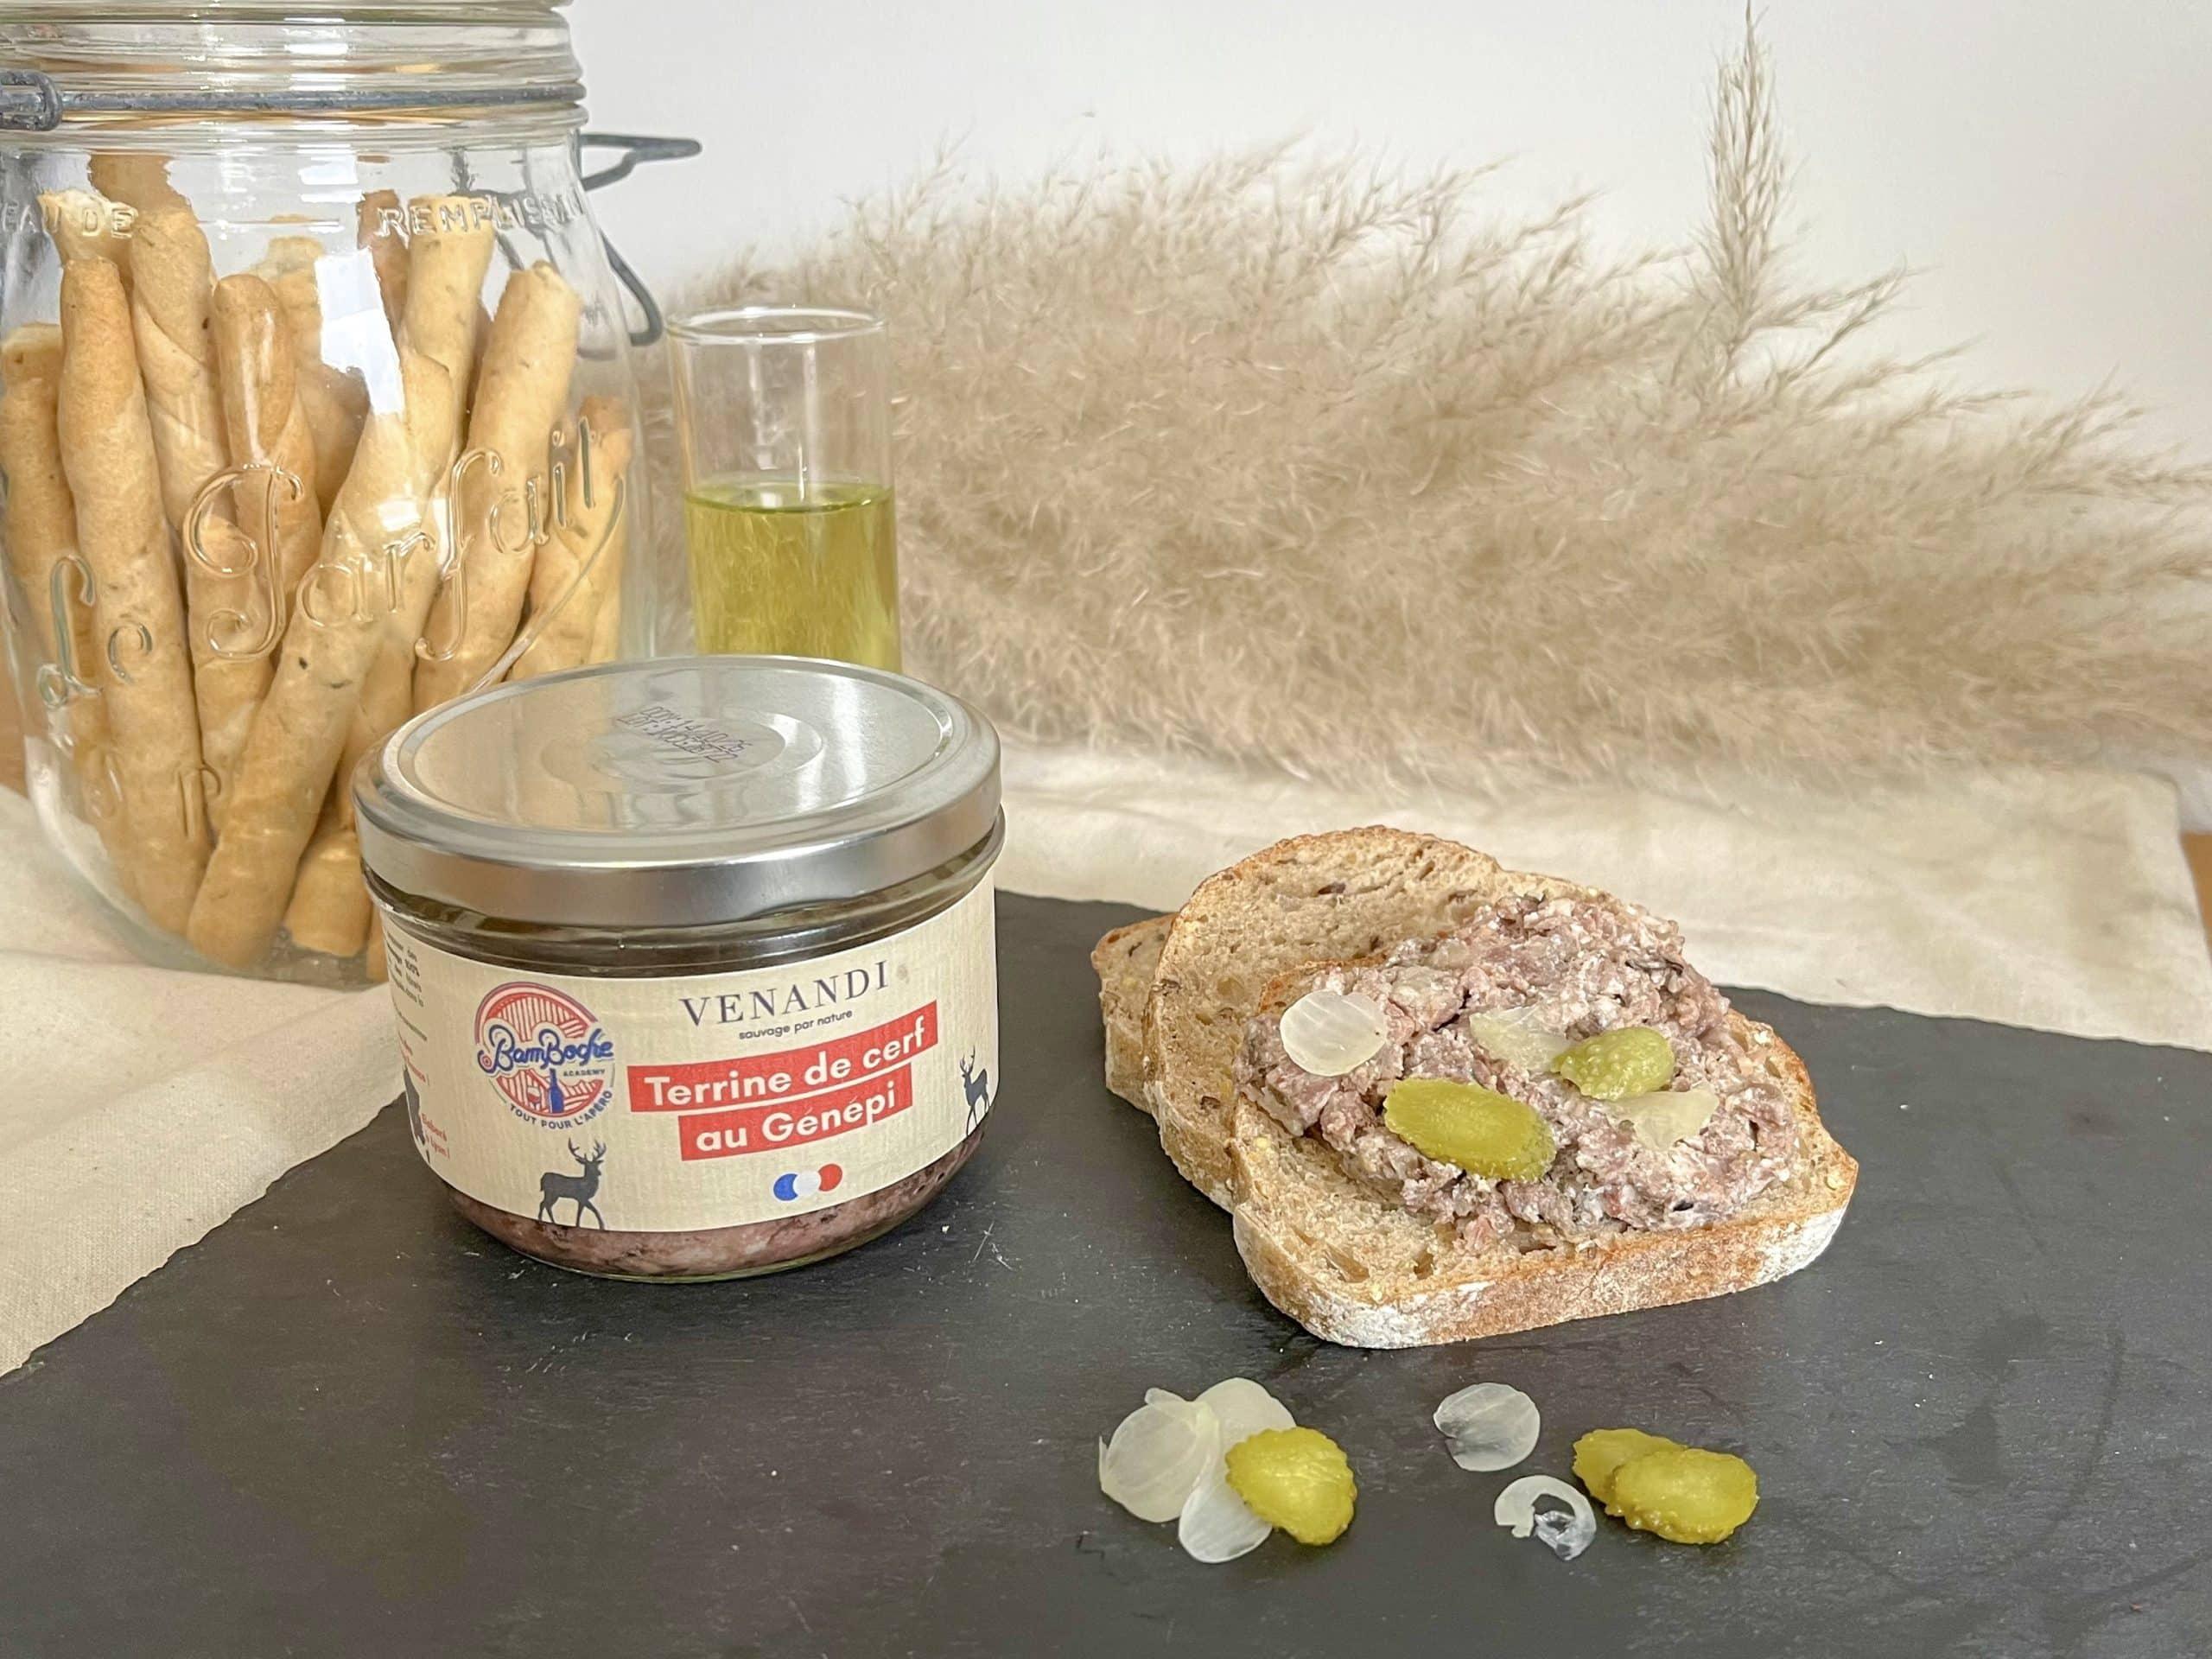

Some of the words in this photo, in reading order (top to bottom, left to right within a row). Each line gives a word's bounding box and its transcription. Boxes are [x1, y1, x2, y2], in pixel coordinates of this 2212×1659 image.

[82, 204, 138, 238] DE
[678, 960, 889, 1027] VENANDI
[739, 1024, 791, 1040] sauvage
[794, 1020, 814, 1036] par
[817, 1009, 853, 1027] nature
[563, 1068, 606, 1077] ACADEMY
[644, 1071, 791, 1106] Terrine
[804, 1051, 851, 1086] de
[862, 1016, 925, 1070] cerf
[510, 1103, 537, 1125] TOUT
[541, 1119, 573, 1129] POUR
[696, 1128, 747, 1152] au
[762, 1081, 895, 1142] Génépi
